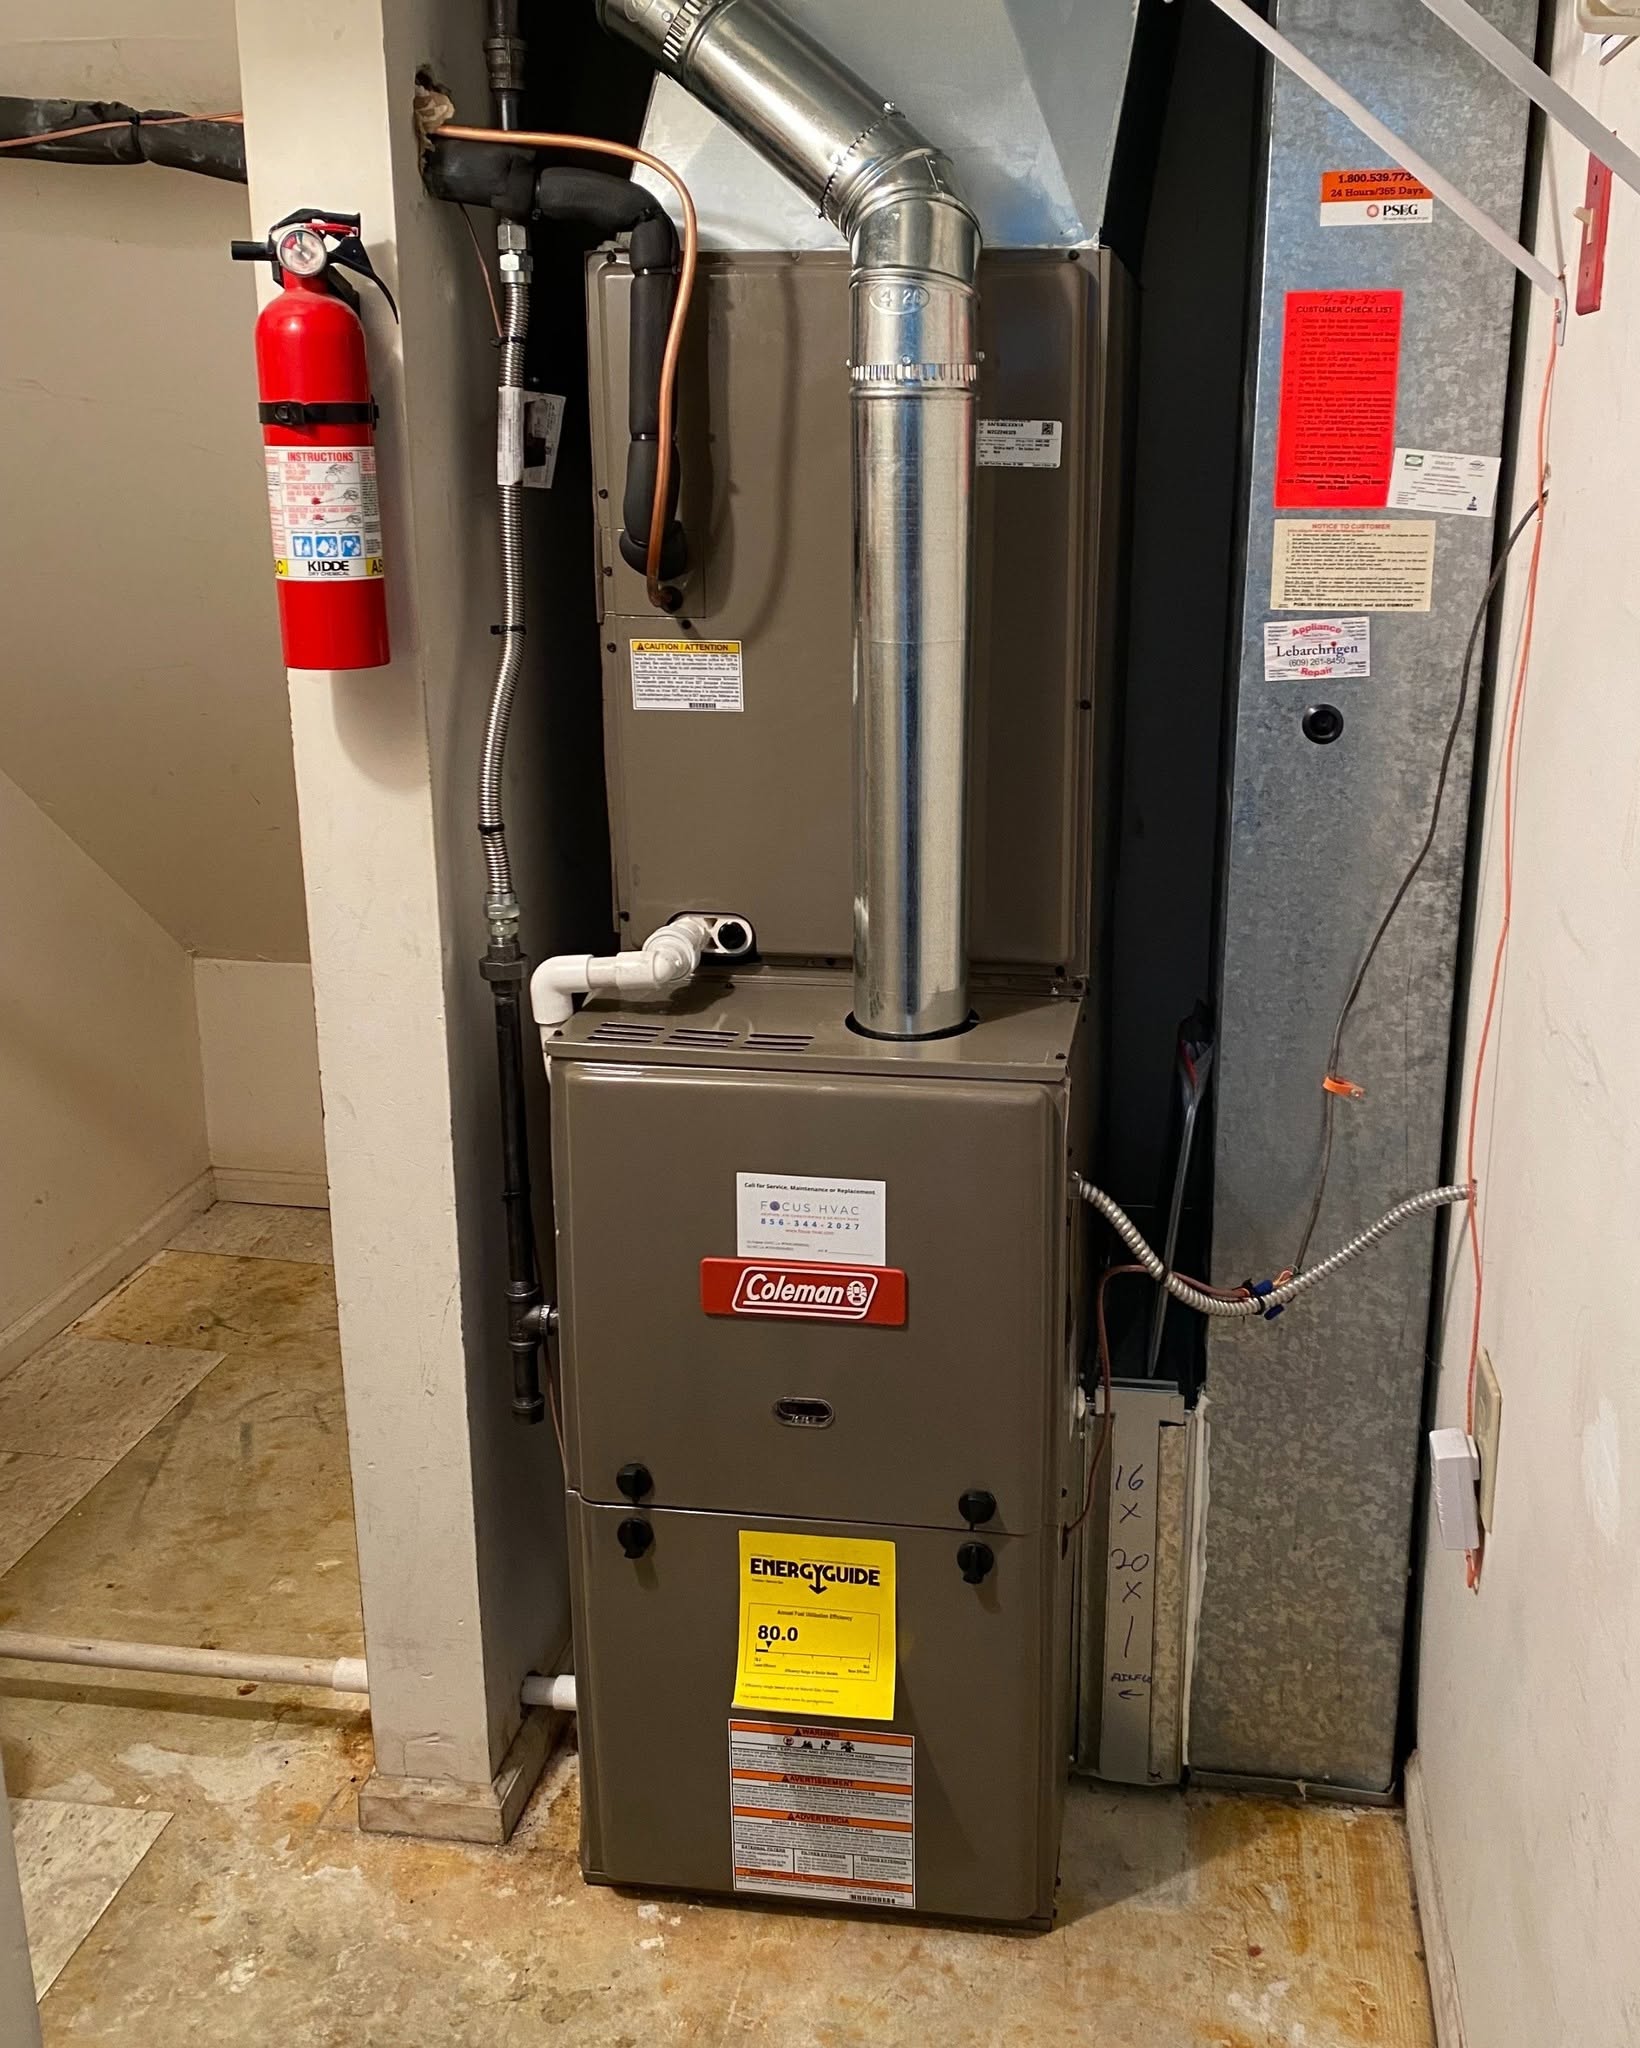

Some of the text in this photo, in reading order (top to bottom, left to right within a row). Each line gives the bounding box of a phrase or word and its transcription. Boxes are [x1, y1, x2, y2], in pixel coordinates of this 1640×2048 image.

[1330, 188, 1342, 198] 24
[1398, 186, 1425, 196] Days
[1296, 306, 1394, 314] CUSTOMER CHECK LIST
[287, 452, 354, 462] INSTRUCTIONS
[308, 560, 350, 572] KIDDE
[1292, 623, 1342, 636] Appliance
[644, 643, 679, 651] CAUTION
[686, 643, 728, 651] ATTENTION
[1276, 642, 1358, 658] Lebarchrigen
[1288, 658, 1308, 668] (609)
[1300, 666, 1333, 677] Repair
[790, 1185, 828, 1193] Maintenance
[837, 1188, 876, 1196] Replacement
[760, 1200, 860, 1216] FOCUS HVAC
[746, 1273, 845, 1304] Coleman
[1115, 1463, 1145, 1491] 16
[1111, 1548, 1150, 1573] 20
[750, 1558, 880, 1587] ENERGYGUIDE
[830, 1613, 853, 1621] Efficiency
[758, 1624, 798, 1642] 80.0
[802, 1728, 840, 1738] WARNING
[788, 1775, 854, 1787] AVERTISSEMENT
[794, 1813, 850, 1824] ADVERTENCIA
